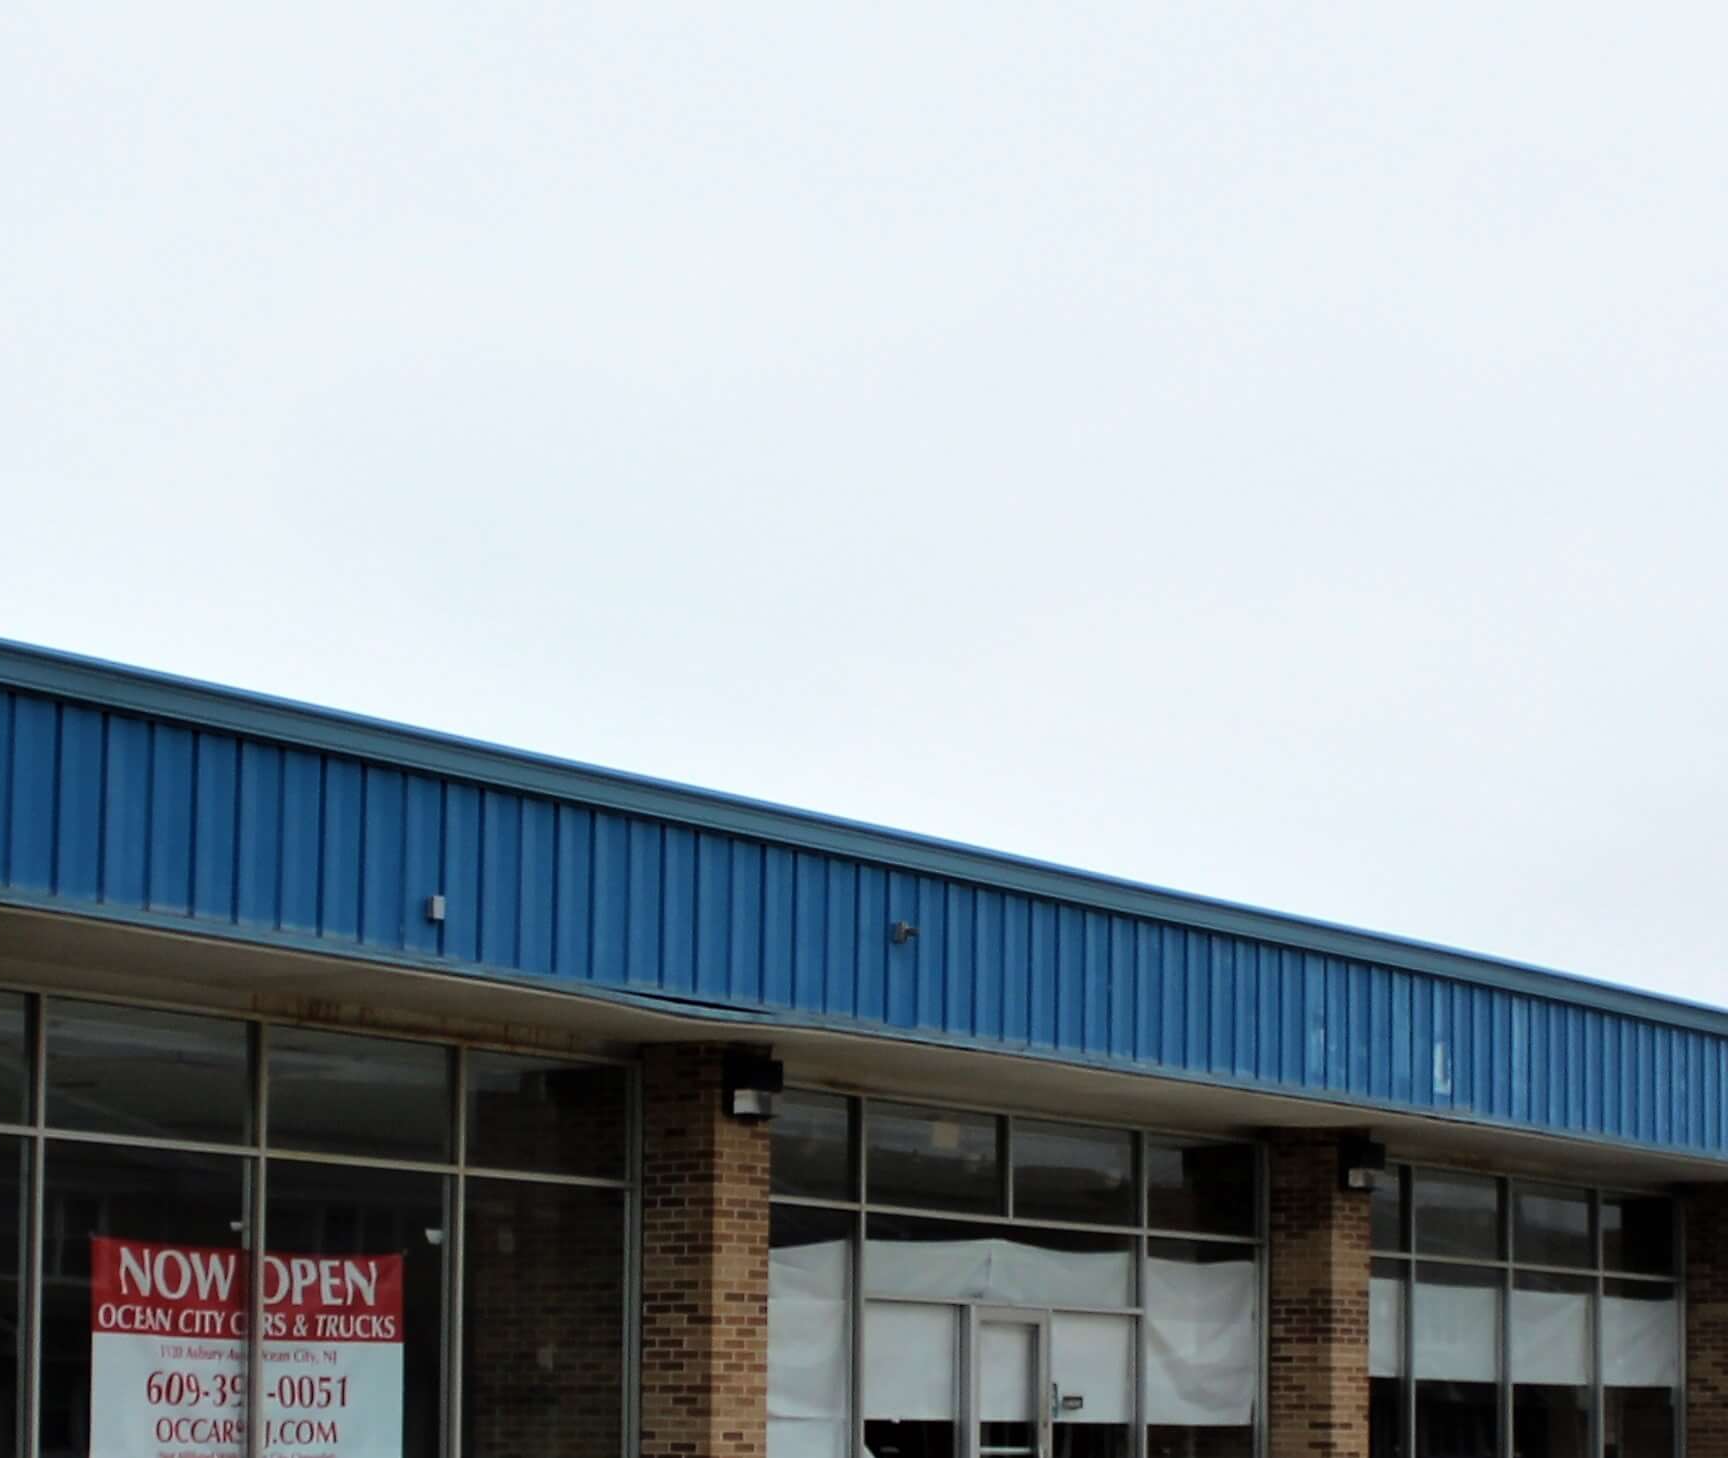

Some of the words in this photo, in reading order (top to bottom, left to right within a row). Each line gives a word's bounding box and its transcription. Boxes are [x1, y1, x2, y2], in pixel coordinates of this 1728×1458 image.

[119, 1247, 235, 1301] NOW
[262, 1255, 377, 1307] OPEN
[97, 1302, 173, 1332] OCEAN
[178, 1307, 226, 1335] CITY
[231, 1311, 288, 1337] CRS
[293, 1314, 309, 1338] &
[315, 1313, 396, 1339] TRUCKS
[146, 1370, 349, 1409] 609-39-0051
[155, 1416, 338, 1449] OCCARSJ.COM
